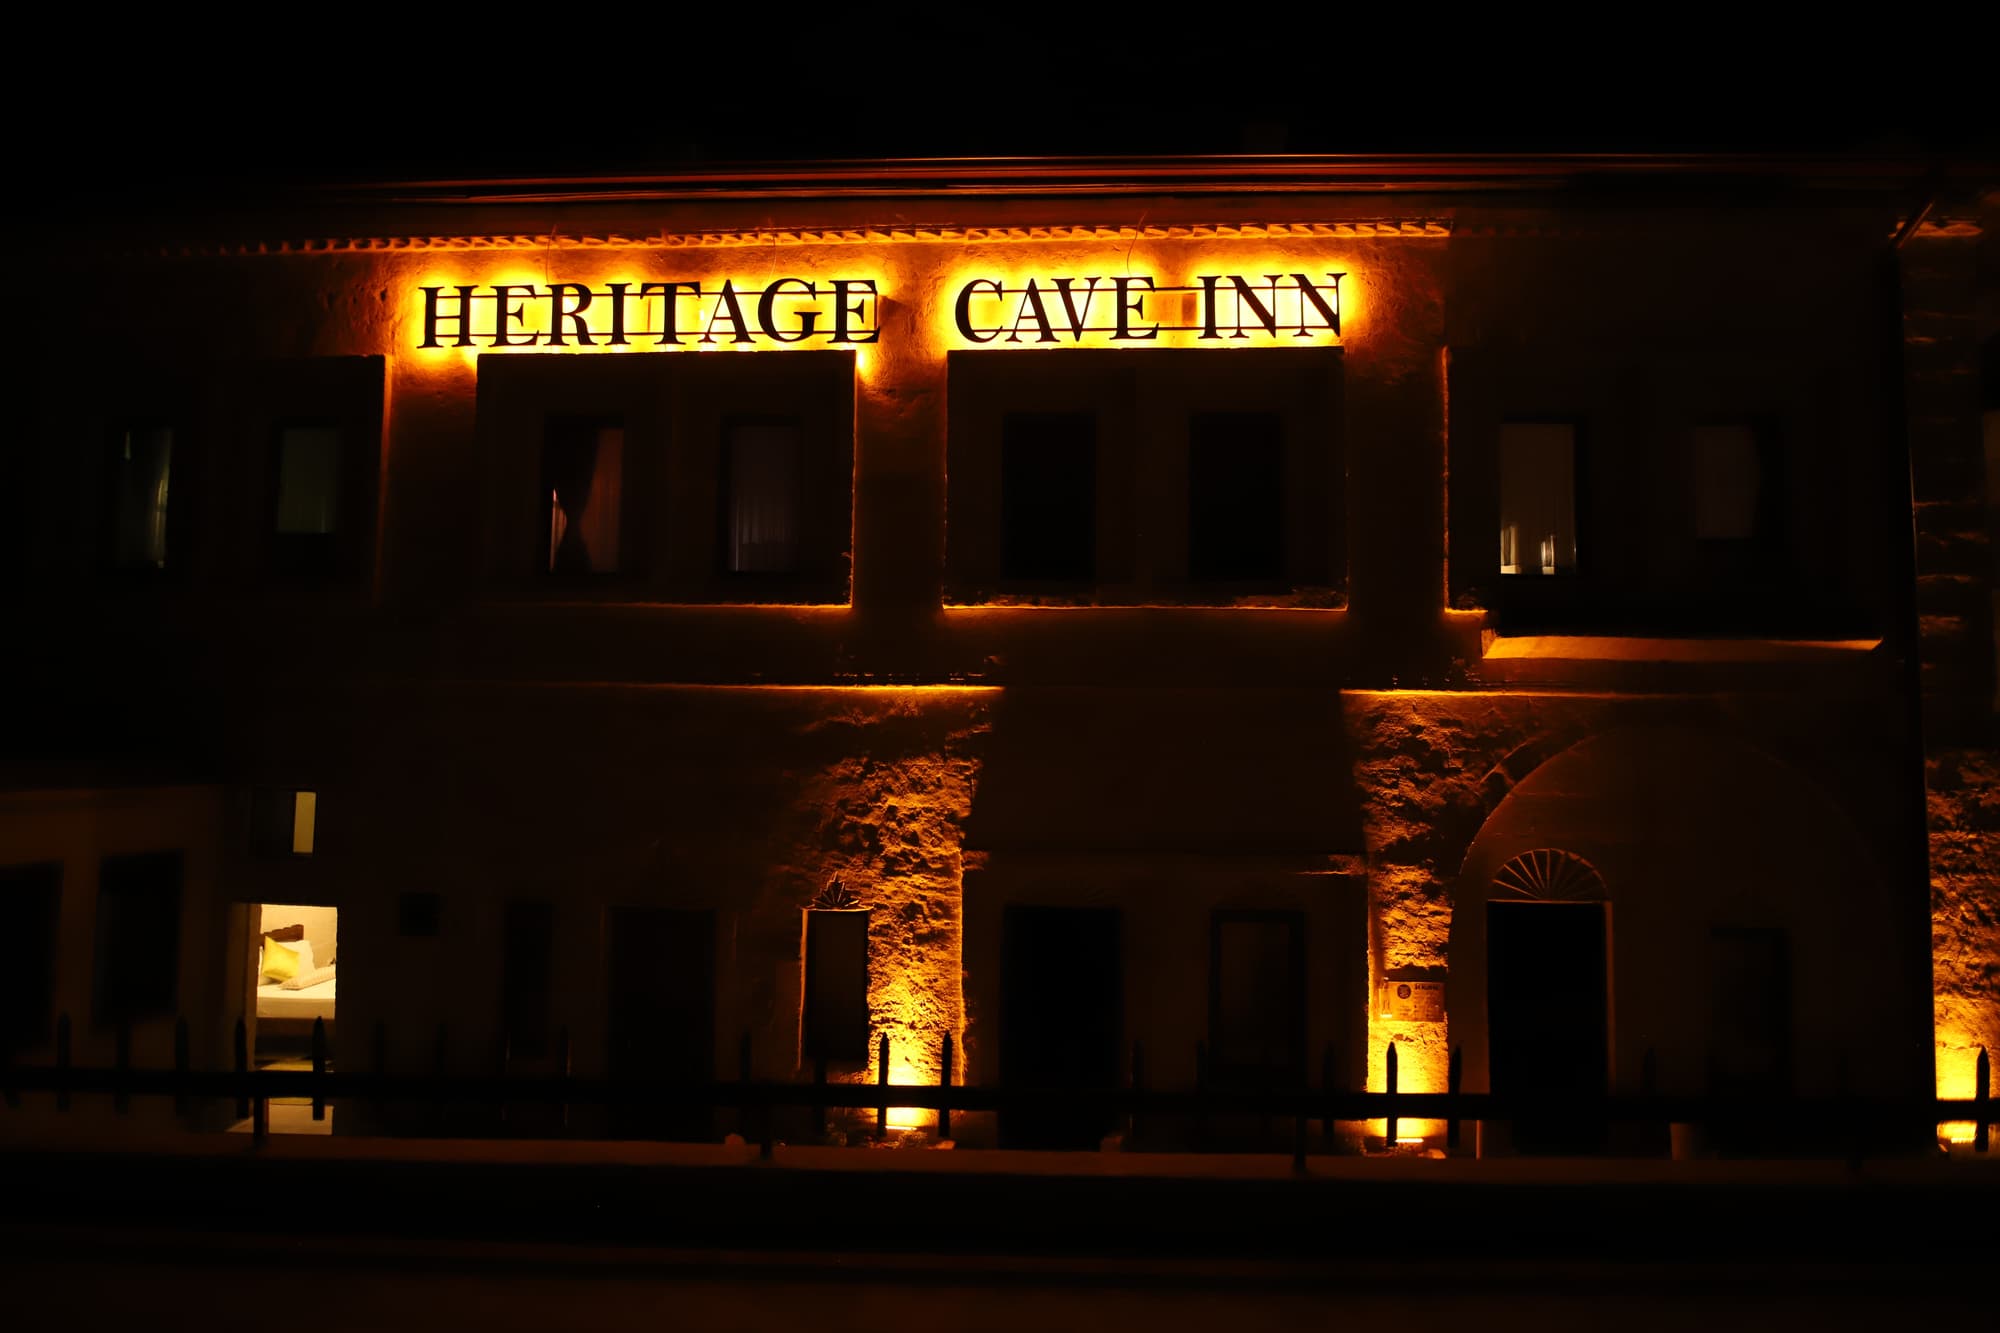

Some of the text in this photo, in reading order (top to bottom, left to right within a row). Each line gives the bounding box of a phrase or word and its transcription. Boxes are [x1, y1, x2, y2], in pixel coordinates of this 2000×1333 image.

[417, 272, 1347, 348] HERITAGE CAVE INN
